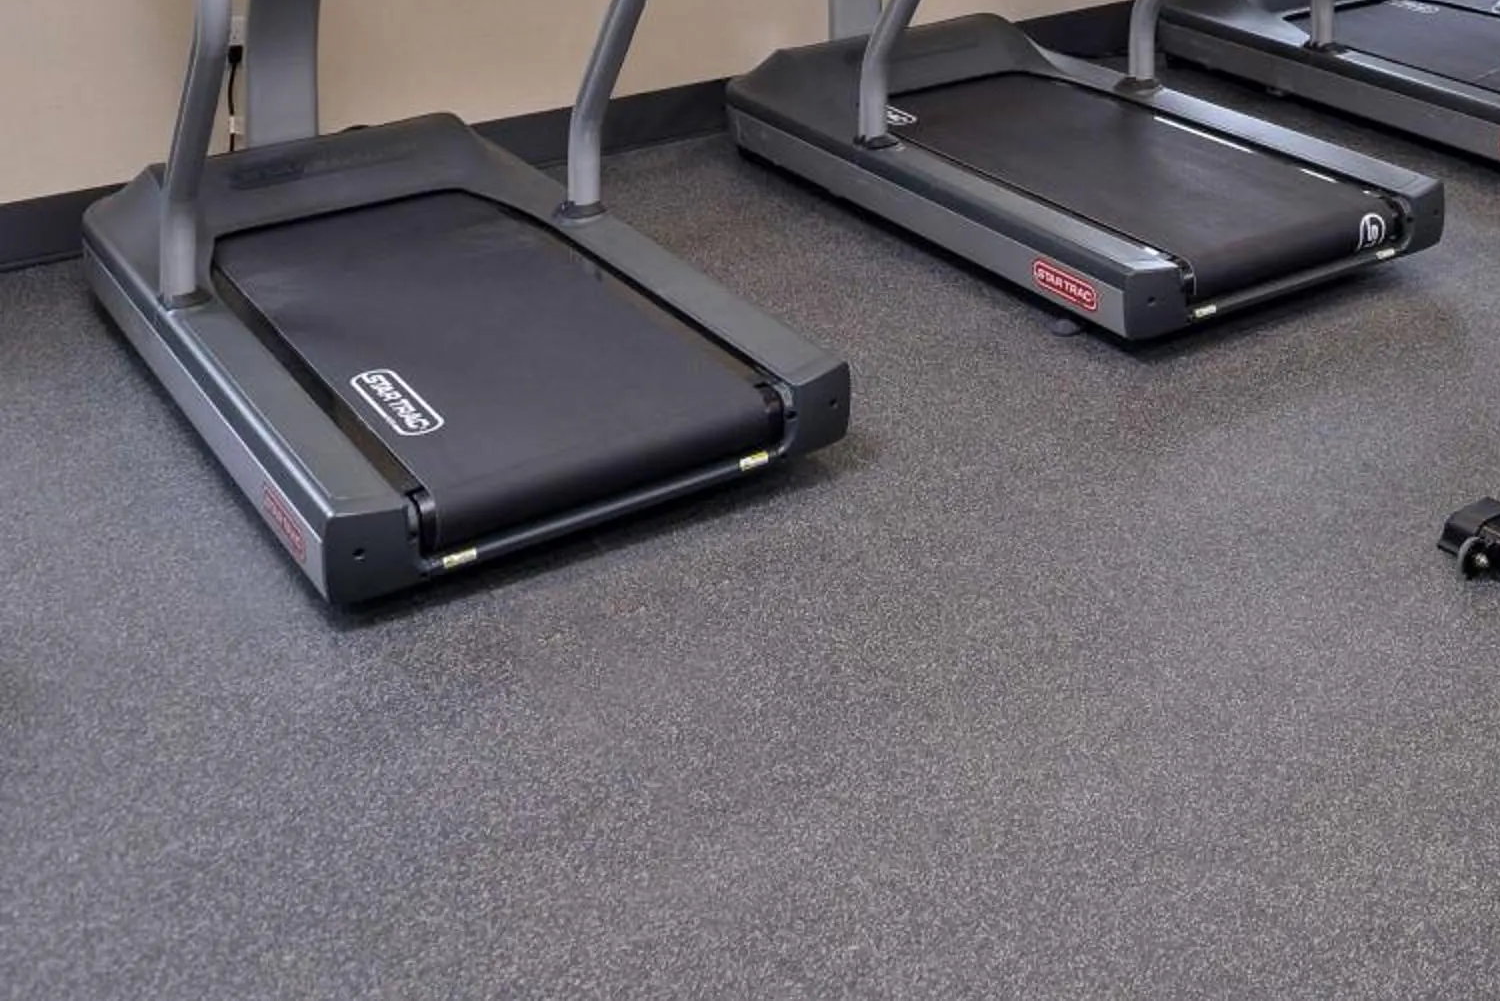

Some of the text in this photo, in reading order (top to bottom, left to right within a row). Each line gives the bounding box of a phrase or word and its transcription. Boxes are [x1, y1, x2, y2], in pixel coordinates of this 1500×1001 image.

[1036, 267, 1093, 303] STAR TRAC
[360, 372, 431, 430] STAR TRAC
